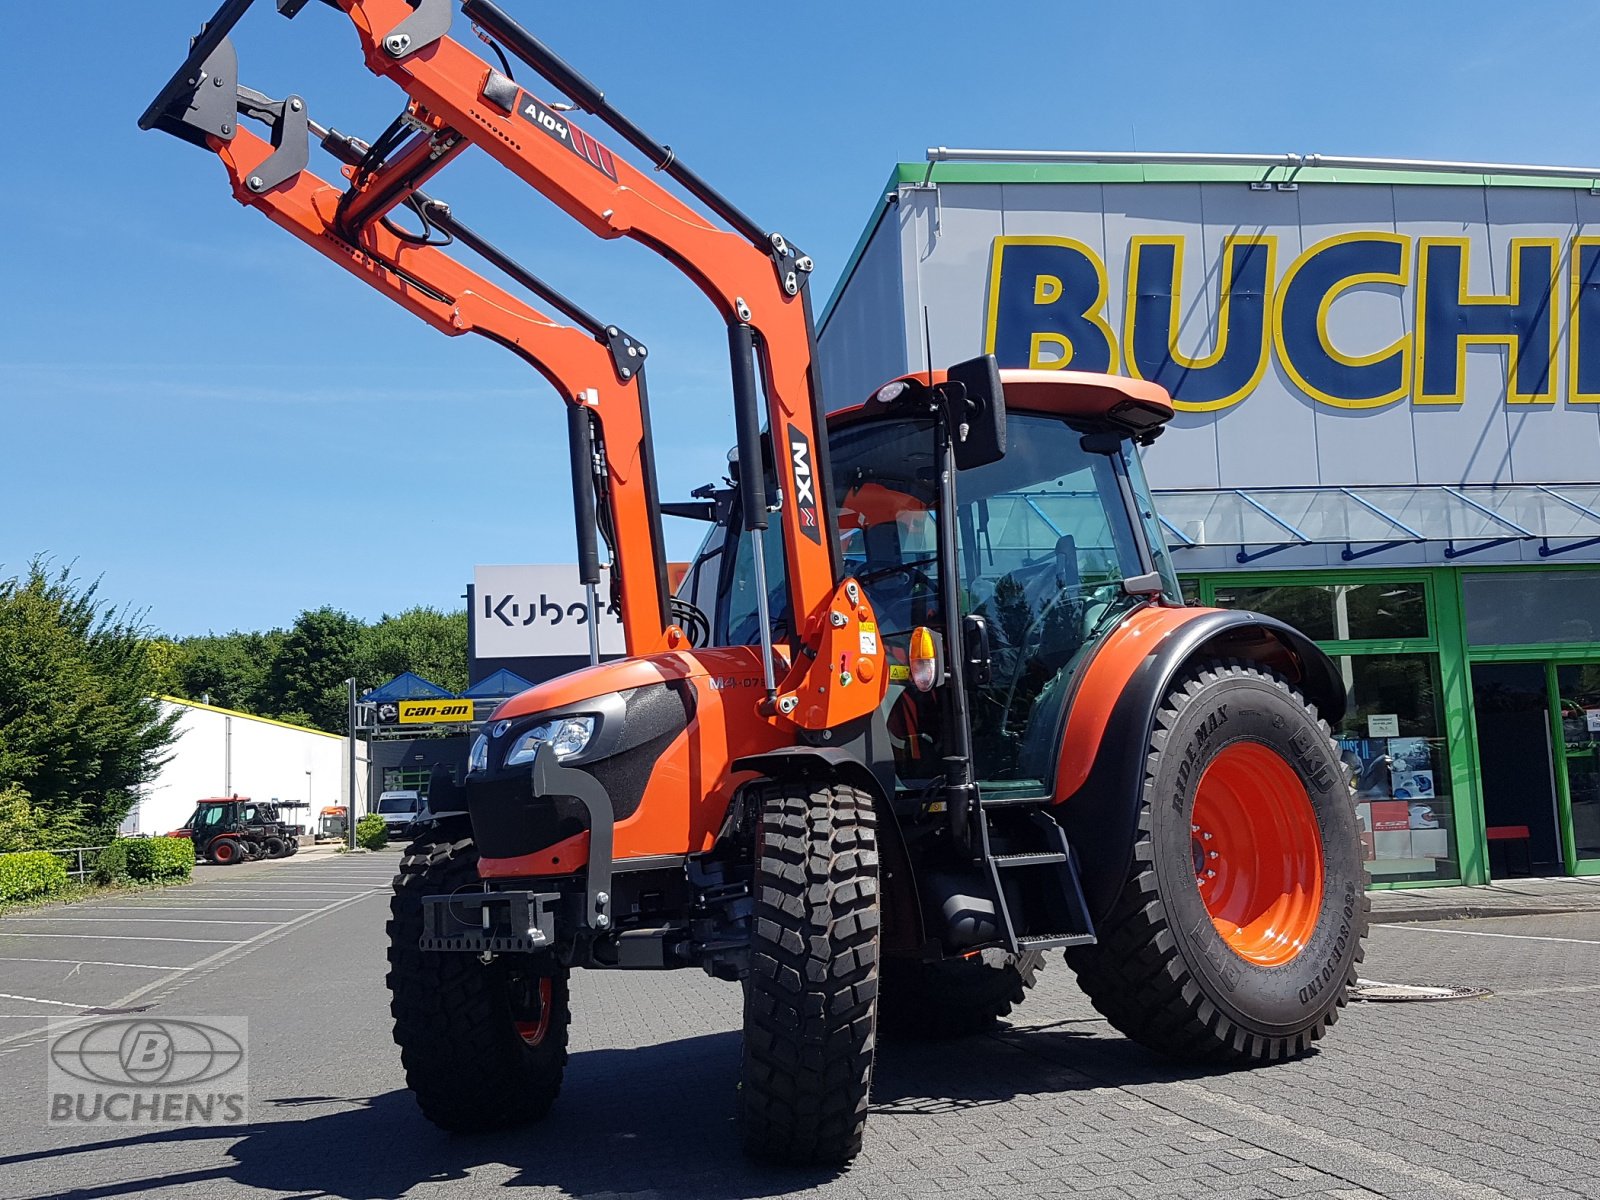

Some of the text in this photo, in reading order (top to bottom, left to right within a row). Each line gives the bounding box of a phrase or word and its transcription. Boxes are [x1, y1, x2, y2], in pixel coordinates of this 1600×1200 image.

[525, 104, 568, 140] A104
[791, 442, 814, 505] MX
[404, 705, 469, 717] can-am
